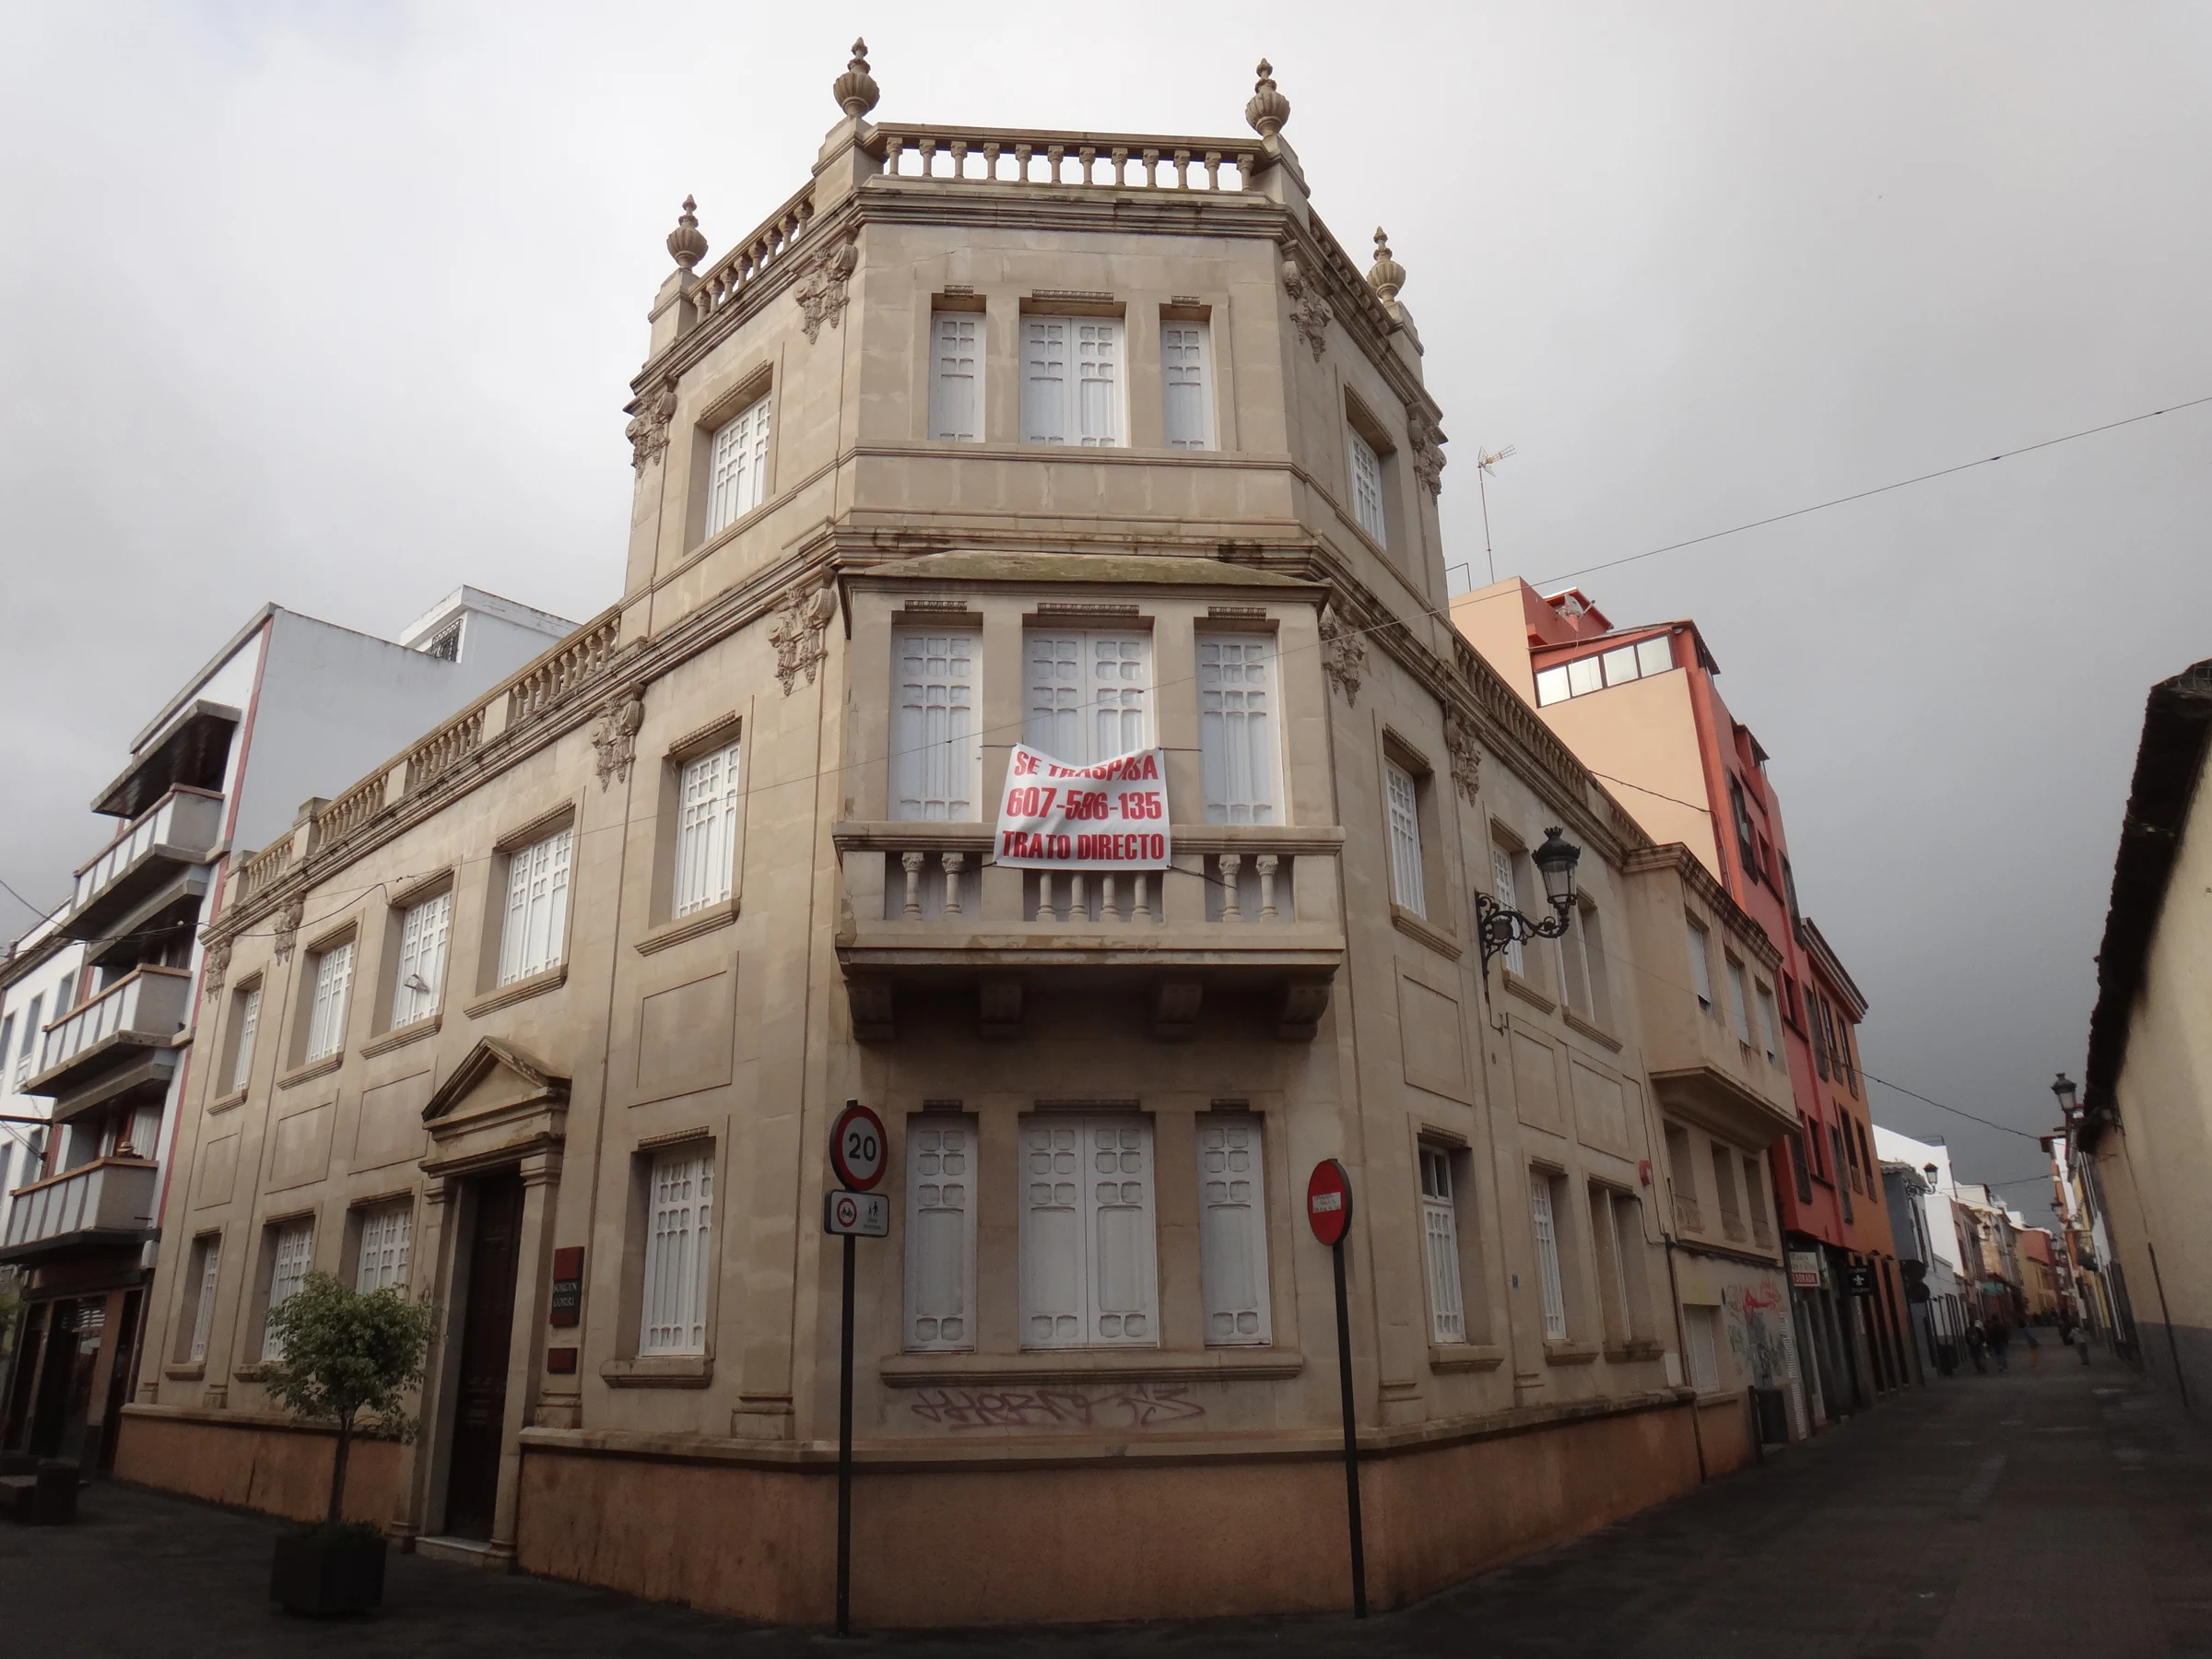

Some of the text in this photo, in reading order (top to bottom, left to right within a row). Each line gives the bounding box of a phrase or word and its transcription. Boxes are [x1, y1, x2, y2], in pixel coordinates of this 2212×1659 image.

[1014, 751, 1042, 776] SE
[1003, 830, 1164, 860] TRATO DIRECTO
[848, 1132, 877, 1162] 20
